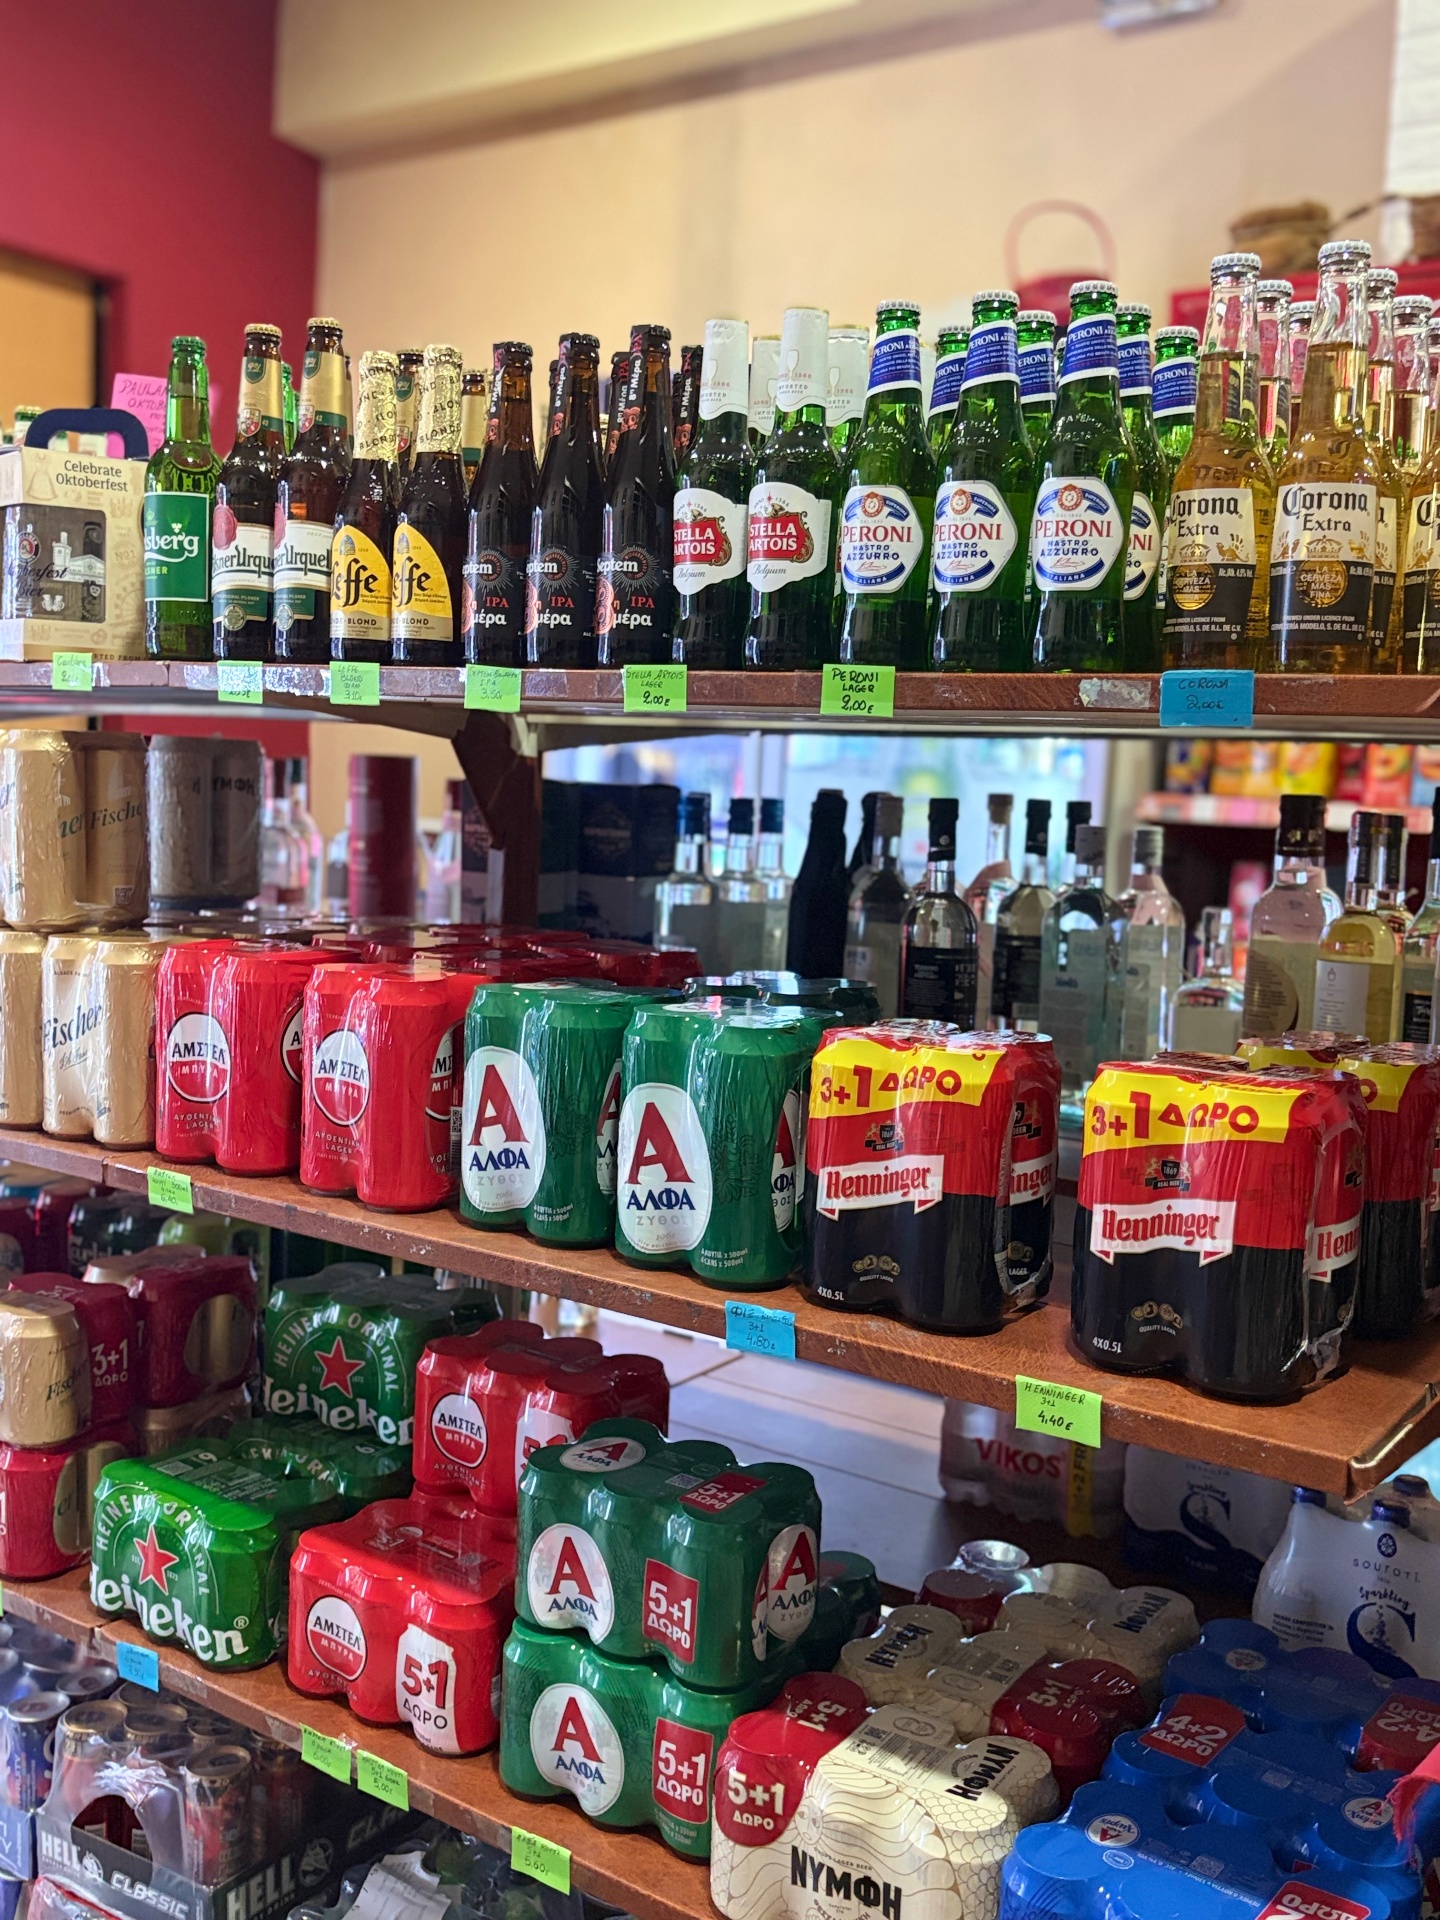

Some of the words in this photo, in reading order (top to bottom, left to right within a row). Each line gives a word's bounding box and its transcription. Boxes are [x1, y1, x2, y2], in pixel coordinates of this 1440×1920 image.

[1068, 326, 1103, 344] PERONI
[1154, 368, 1188, 384] PERONI
[64, 460, 122, 477] Celebrate
[56, 473, 128, 492] Oktoberfest
[1171, 494, 1240, 526] Corona
[1282, 486, 1368, 519] Corona
[751, 522, 797, 536] STELLA
[934, 523, 1002, 541] PERONI
[1035, 519, 1112, 539] PERONI
[1177, 519, 1219, 537] Extra
[1302, 513, 1351, 532] Extra
[674, 528, 715, 541] STELLA
[750, 537, 797, 551] ARTOIS
[843, 526, 912, 543] PERONI
[674, 542, 715, 556] ARTOIS
[937, 551, 988, 560] AZZURRO
[942, 542, 978, 550] NASTRO
[1040, 548, 1099, 557] AZZURRO
[847, 553, 900, 561] AZZURRO
[676, 568, 706, 582] Belgium
[752, 563, 787, 579] Belgium
[485, 597, 509, 608] IPA
[551, 596, 574, 608] IPA
[631, 596, 654, 608] IPA
[347, 618, 377, 626] BLOND
[473, 609, 507, 628] μέρα
[536, 609, 572, 628] μέρα
[614, 609, 652, 629] μέρα
[625, 668, 652, 679] STELLA
[654, 669, 685, 680] ARTOIS
[831, 668, 878, 683] PERONI
[1178, 678, 1229, 690] CORONA
[641, 680, 663, 689] LAGER
[842, 683, 874, 692] LAGER
[317, 1059, 368, 1083] ΑΜΣΤΕΛ
[878, 1066, 962, 1096] ΔΩΡΟ
[820, 1064, 872, 1108] 3+1
[1091, 1091, 1152, 1140] 3+1
[1157, 1102, 1260, 1134] ΔΩΡΟ
[469, 1147, 531, 1172] ΑΛΦΑ
[1163, 1166, 1178, 1176] 1869
[826, 1165, 931, 1200] Henninger
[626, 1188, 696, 1211] ΑΛΦΑ
[1101, 1205, 1220, 1245] Henninger
[817, 1285, 844, 1301] 4X0.5L
[748, 1321, 764, 1332] 3+1
[1092, 1336, 1122, 1354] 4X0.5L
[91, 1338, 128, 1376] 3+1
[1025, 1382, 1086, 1405] HENNINGER
[1040, 1397, 1055, 1407] 3+1
[437, 1413, 483, 1440] ΑΜΣΤΕΛ
[445, 1431, 476, 1450] ΜΠΥΡΑ
[976, 1438, 1061, 1479] VIKOS
[685, 1490, 728, 1510] ΔΩΡΟ
[698, 1483, 744, 1505] 5+1
[648, 1580, 692, 1633] 5+1
[1359, 1586, 1410, 1611] Sparkling
[548, 1597, 598, 1621] ΑΛΦΑ
[313, 1615, 362, 1651] ΑΜΣΤΕΛ
[646, 1614, 691, 1649] ΔΩΡΟ
[320, 1637, 354, 1663] ΜΠΥΡΑ
[401, 1653, 449, 1709] 5+1
[403, 1697, 448, 1730] ΔΩΡΟ
[797, 1701, 847, 1732] 5+1
[1164, 1715, 1229, 1748] 4+2
[1150, 1729, 1212, 1757] ΔΩΡΟ
[555, 1754, 606, 1784] ΑΛΦΑ
[657, 1739, 706, 1787] 5+1
[944, 1742, 1020, 1801] ΝΥΜΦΗ
[656, 1776, 703, 1806] ΔΩΡΟ
[727, 1772, 785, 1816] 5+1
[732, 1808, 775, 1831] ΔΩΡΟ
[40, 1830, 83, 1872] HELL
[856, 1862, 873, 1871] BEER
[790, 1844, 902, 1920] ΝΥΜΦΗ
